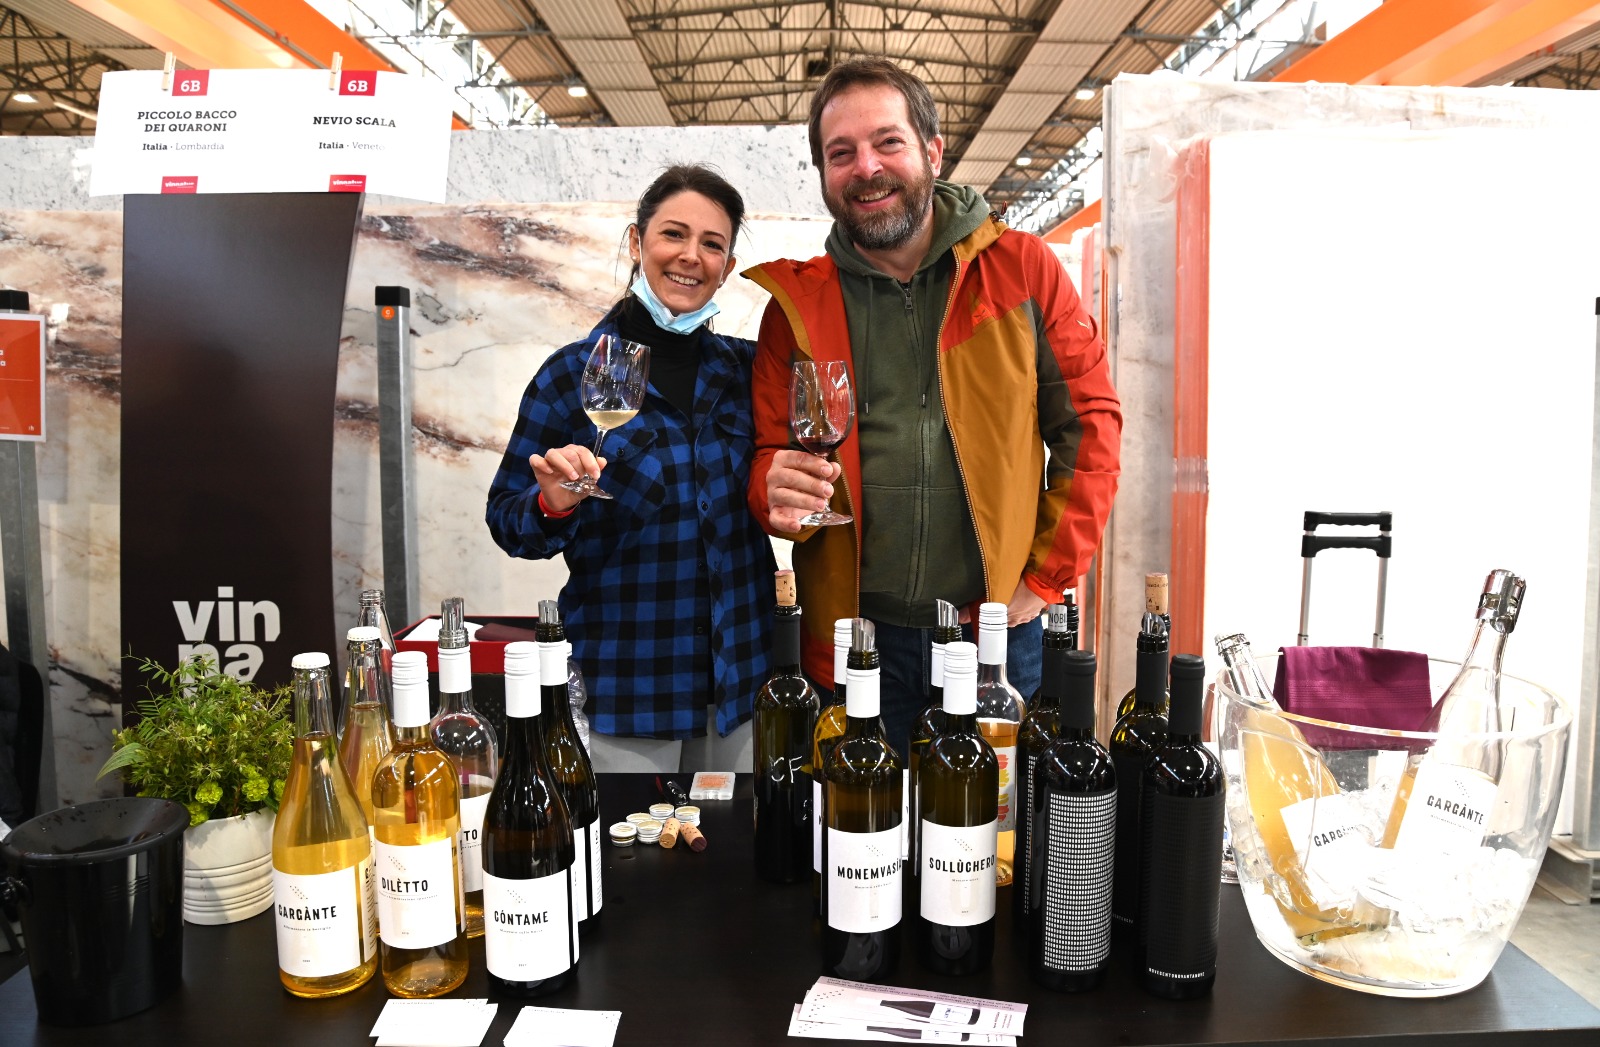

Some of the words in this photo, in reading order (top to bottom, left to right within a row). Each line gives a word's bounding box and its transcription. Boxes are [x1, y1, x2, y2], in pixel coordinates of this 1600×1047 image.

[180, 80, 201, 92] 6B
[347, 80, 369, 92] 6B
[137, 110, 192, 120] PICCOLO
[195, 110, 237, 120] BACCO
[144, 123, 166, 132] DEI
[168, 122, 227, 132] QUARONI
[312, 116, 353, 125] NEVIO
[355, 116, 396, 128] SCALA
[142, 143, 168, 151] Italia
[175, 142, 225, 151] Lombardia
[318, 142, 344, 150] Italia
[172, 586, 281, 642] vin
[1426, 795, 1484, 825] GARGÀNTE
[929, 854, 995, 873] SOLLÙCHERO
[381, 876, 429, 893] DILÈTTO
[278, 904, 337, 921] GARGÀNTE
[494, 910, 549, 926] CÓNTAME
